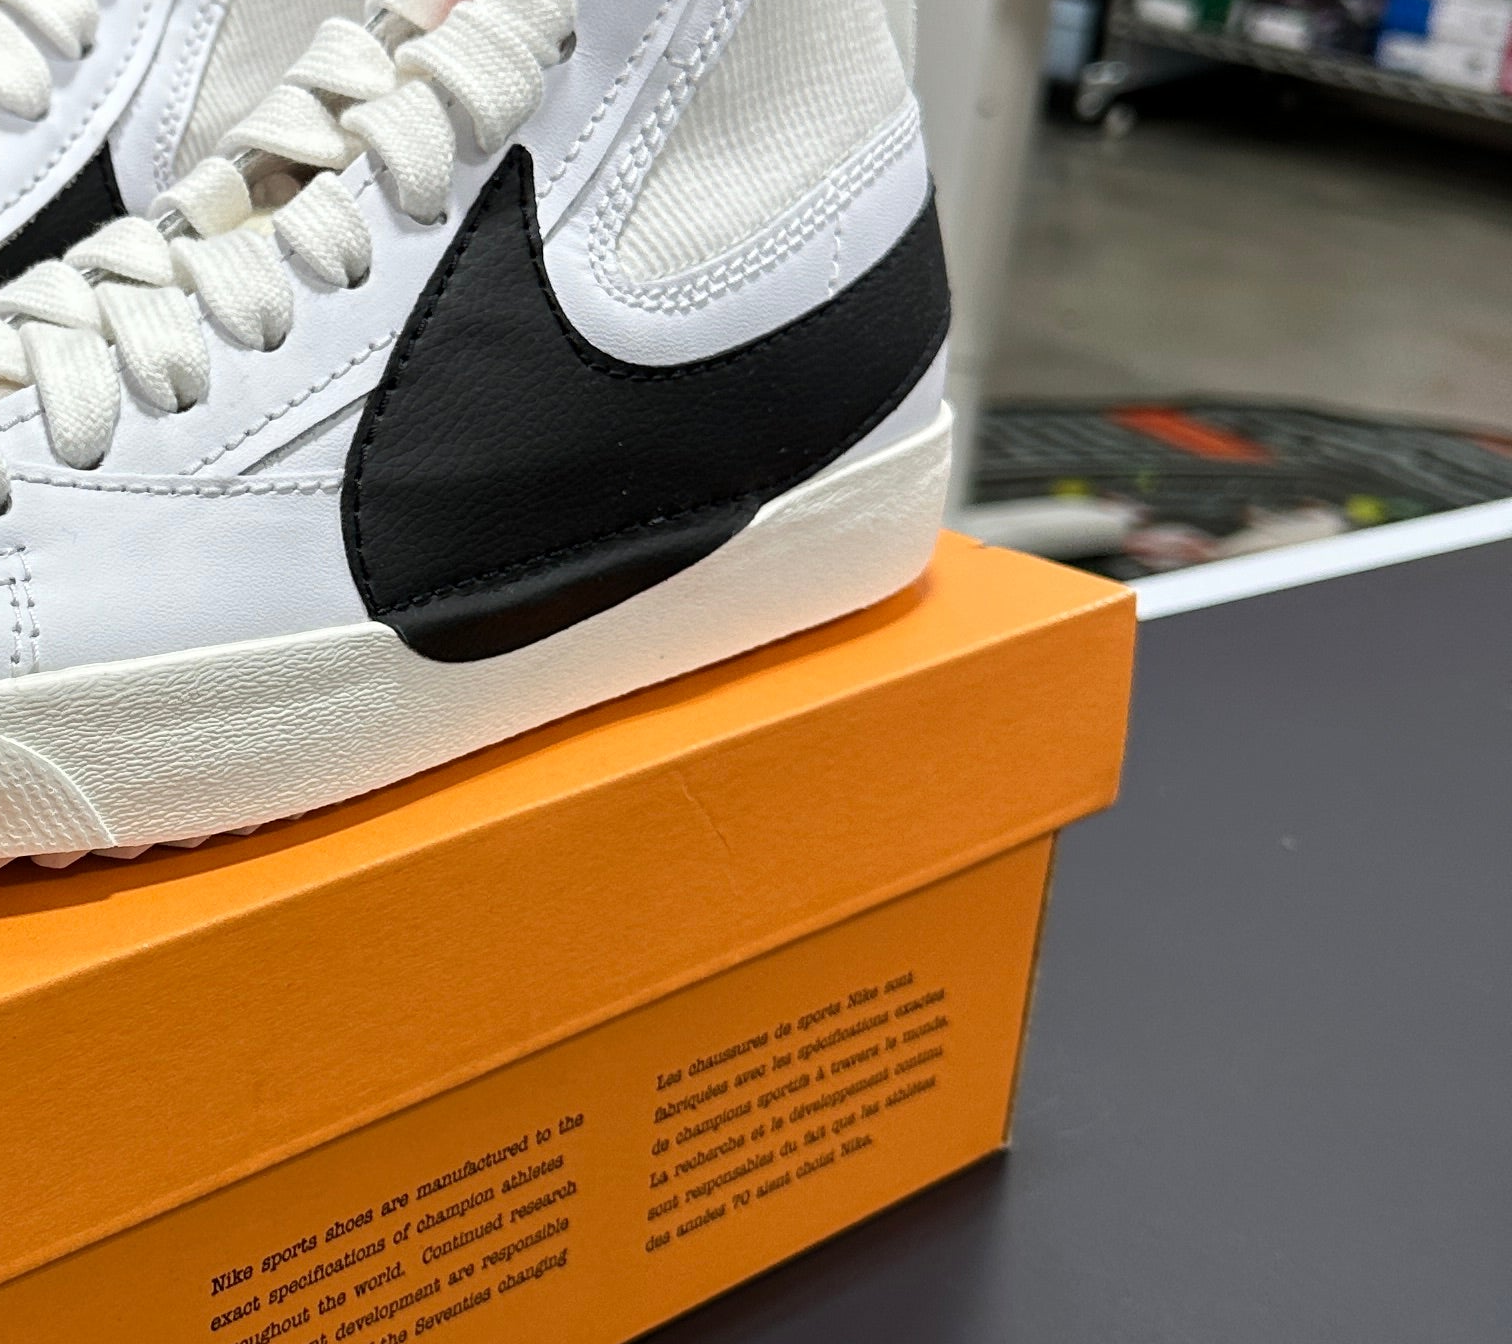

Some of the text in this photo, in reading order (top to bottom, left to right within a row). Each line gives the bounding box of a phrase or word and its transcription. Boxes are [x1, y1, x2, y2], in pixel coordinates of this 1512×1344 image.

[656, 1069, 682, 1091] Les
[688, 1032, 768, 1077] chaussures
[774, 1022, 791, 1039] de
[848, 986, 878, 1008] Nike
[734, 1064, 766, 1088] avec
[772, 1052, 791, 1071] les
[649, 1170, 668, 1188] La
[674, 1134, 745, 1177] recherche
[751, 1124, 765, 1141] et
[771, 1116, 784, 1131] le
[652, 1138, 669, 1156] de
[676, 1101, 751, 1145] champions
[211, 1113, 584, 1296] Nike sports shoes are manufactured to the
[645, 1230, 670, 1253] des
[732, 1189, 750, 1210] 70
[647, 1195, 679, 1221] sont
[685, 1150, 774, 1203] responsables
[779, 1140, 797, 1157] du
[210, 1154, 564, 1331] exact specifications of champion athletes
[318, 1292, 346, 1315] the
[354, 1261, 405, 1298] world.
[422, 1213, 503, 1265] Continued
[510, 1180, 577, 1223] research
[335, 1278, 440, 1341] development
[448, 1263, 474, 1286] are
[481, 1216, 569, 1270] responsible
[415, 1287, 491, 1336] Seventies
[497, 1248, 568, 1294] changing
